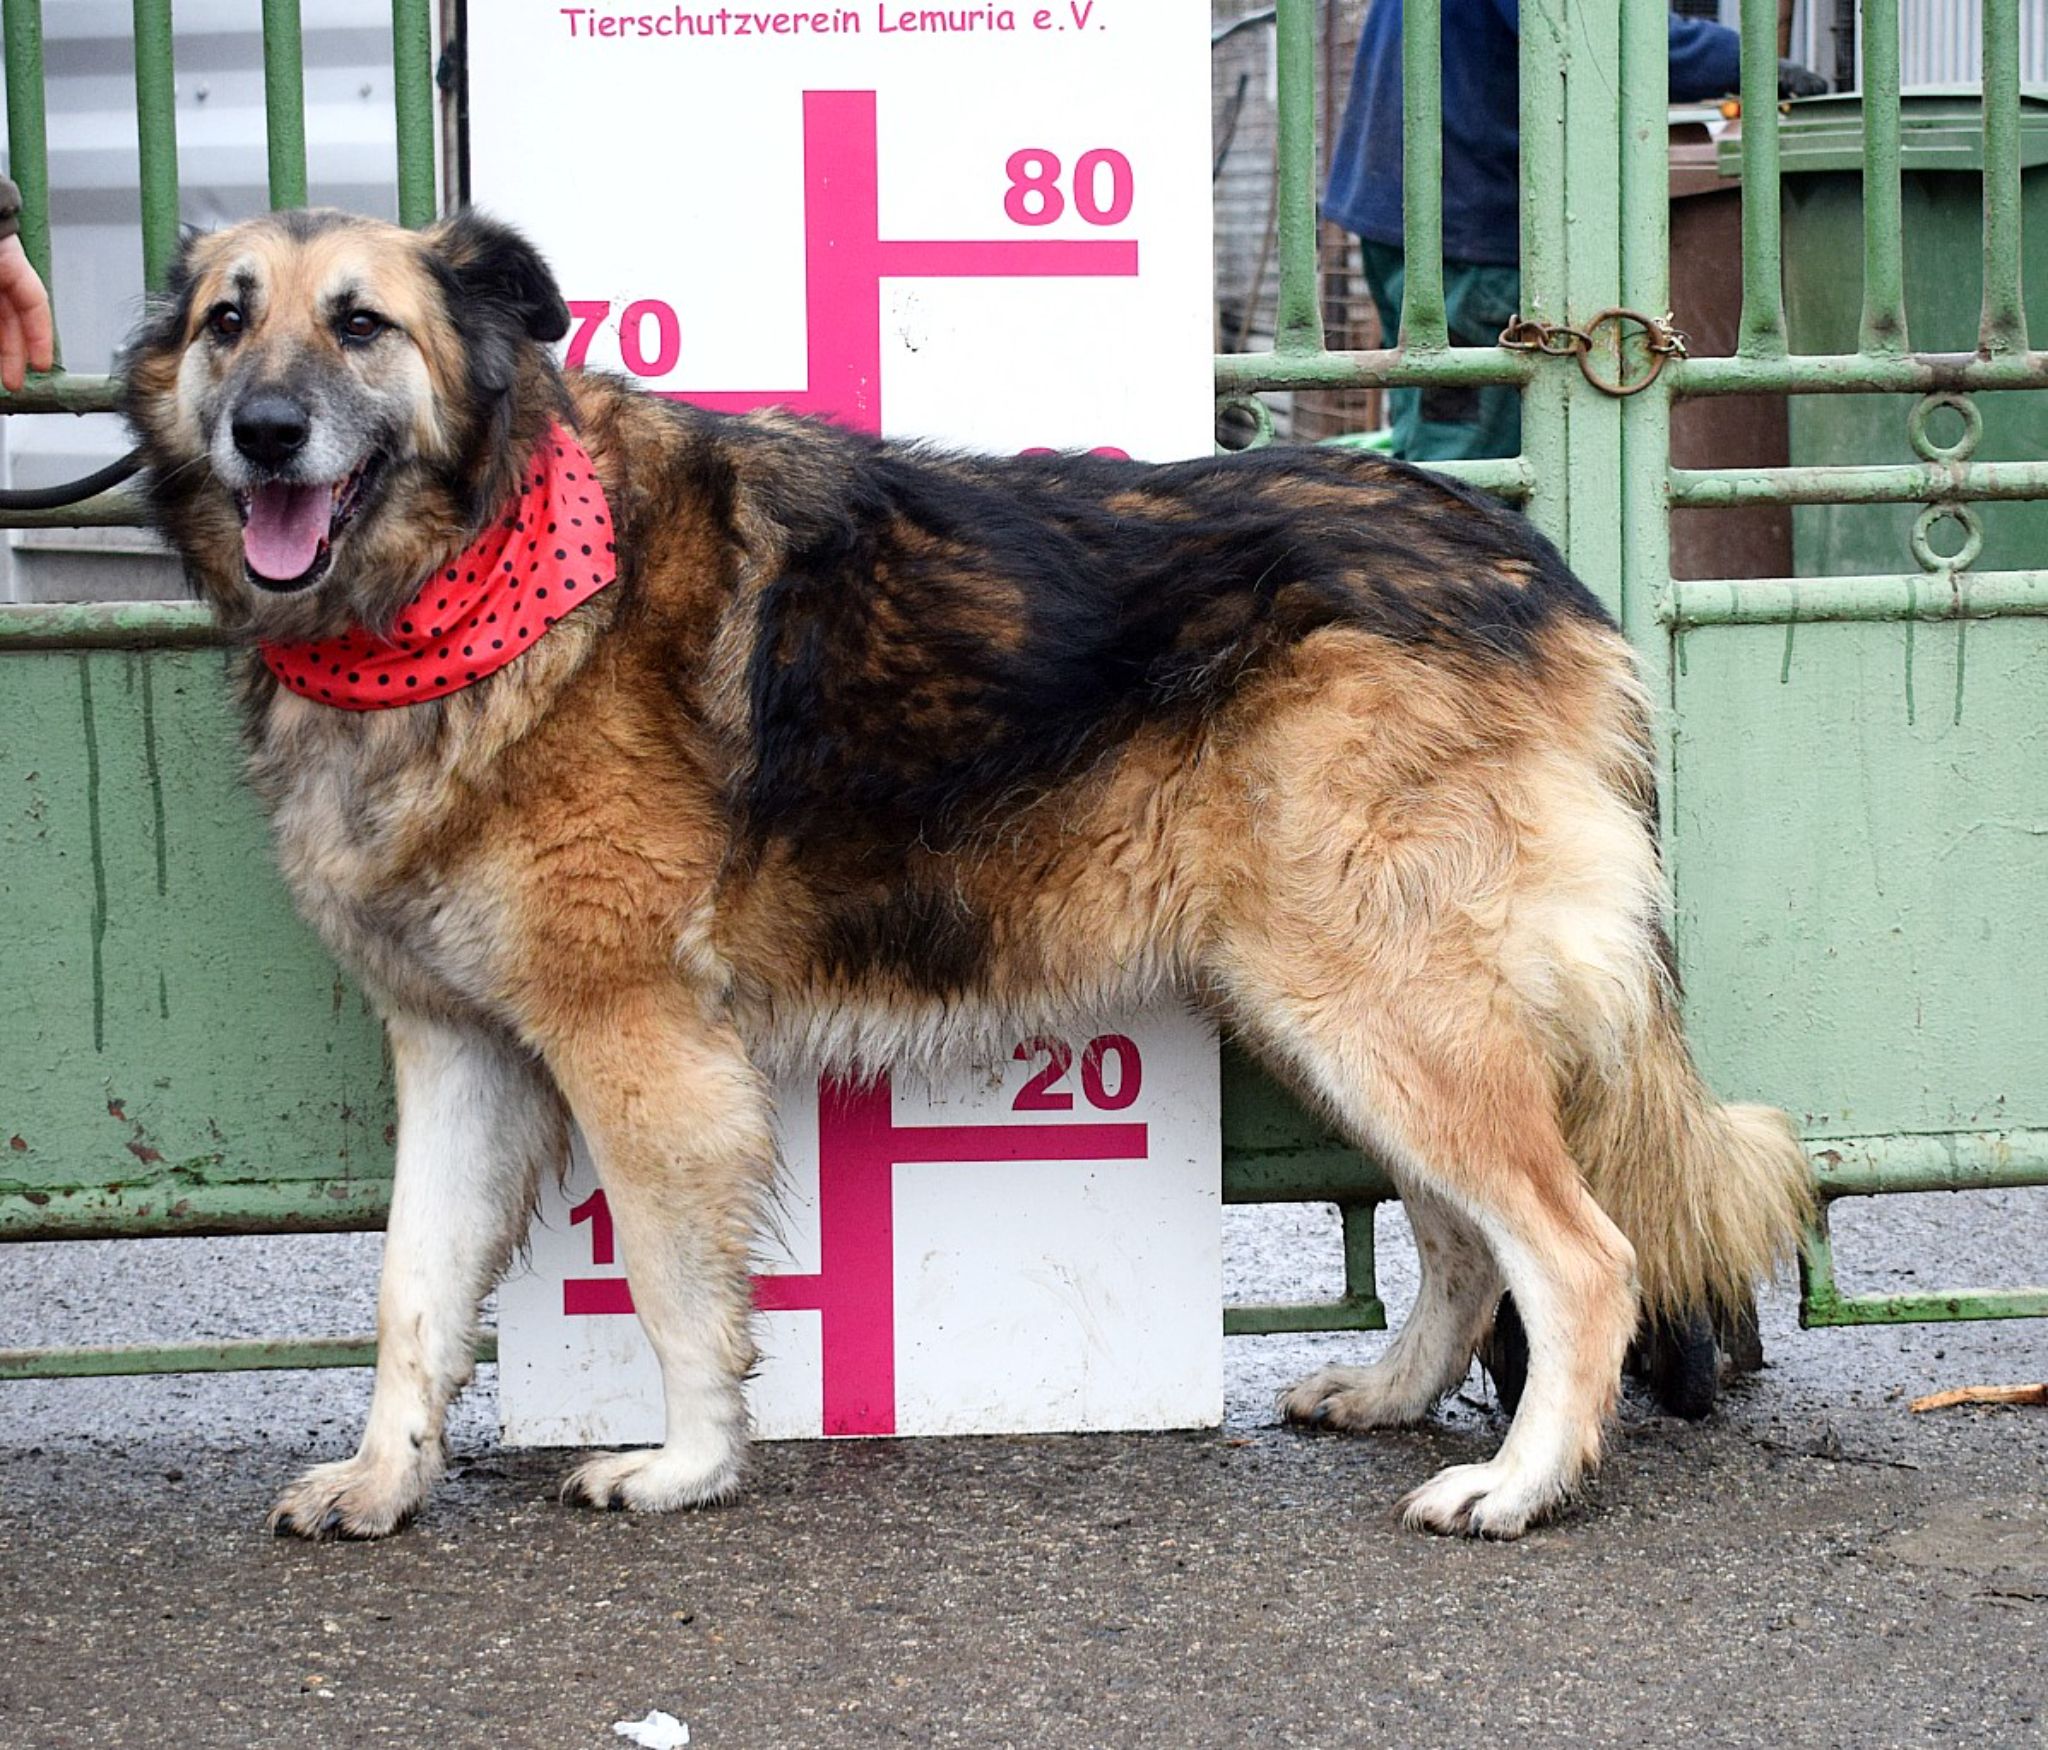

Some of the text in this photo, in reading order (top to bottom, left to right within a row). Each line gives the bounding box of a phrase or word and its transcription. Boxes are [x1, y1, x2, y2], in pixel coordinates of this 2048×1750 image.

[559, 0, 1106, 37] Tierschutzverein Lemuria e.V.
[1003, 147, 1135, 227] 80
[564, 299, 682, 377] 70
[1012, 1034, 1142, 1111] 20
